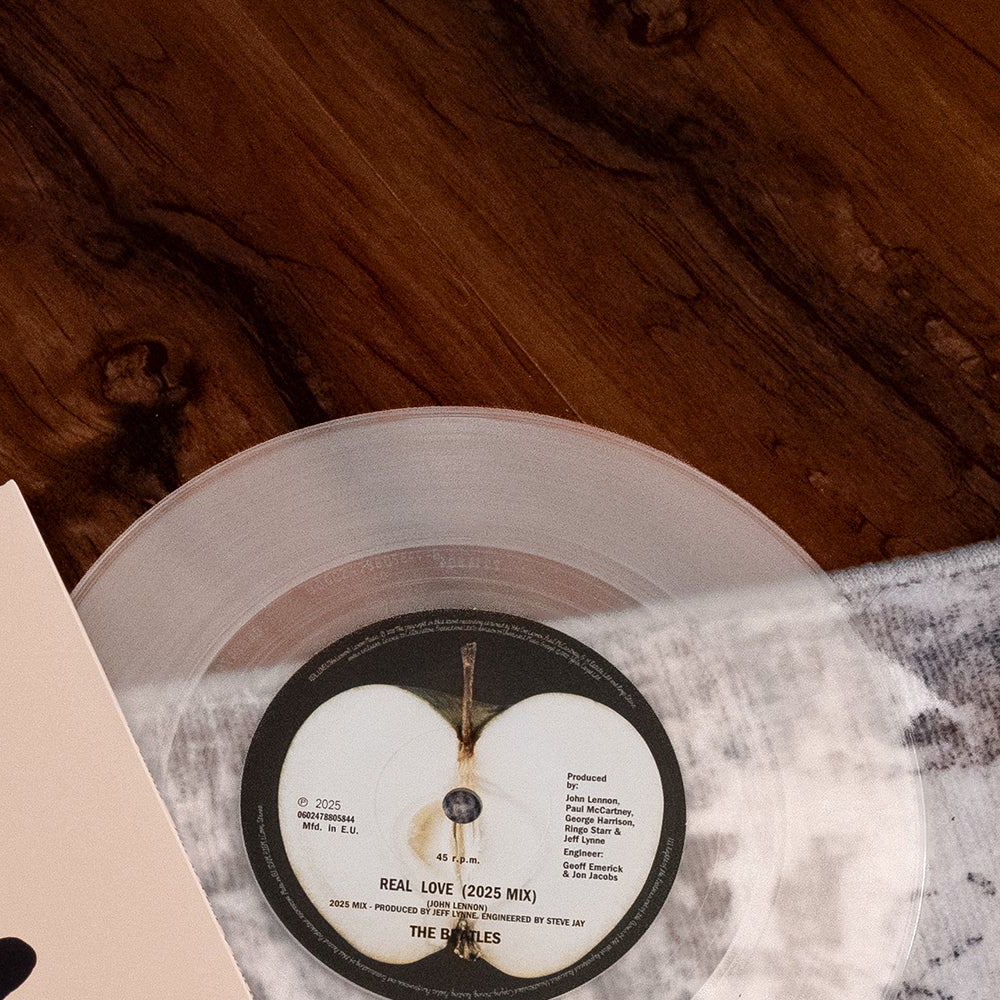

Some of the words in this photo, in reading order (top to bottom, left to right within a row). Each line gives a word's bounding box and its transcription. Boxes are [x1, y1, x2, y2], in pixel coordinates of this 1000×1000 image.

[567, 772, 607, 782] Produced
[566, 781, 579, 790] by:
[315, 798, 342, 811] 2025
[565, 794, 585, 803] John
[587, 796, 620, 805] Lennon,
[565, 804, 584, 813] Paul
[586, 806, 634, 817] McCartney,
[297, 810, 355, 824] 0602478805844
[565, 814, 595, 825] George
[597, 817, 635, 828] Harrison,
[302, 822, 322, 831] Mfd.
[341, 825, 359, 835] E.U.
[564, 825, 589, 835] Ringo
[590, 826, 612, 835] Starr
[614, 828, 621, 836] &
[563, 835, 580, 843] Jeff
[581, 836, 606, 846] Lynne
[436, 853, 448, 862] 45
[452, 856, 480, 865] r.p.m.
[563, 848, 604, 858] Engineer:
[562, 861, 586, 870] Geoff
[589, 862, 624, 873] Emerick
[562, 870, 570, 878] &
[572, 871, 587, 879] Jon
[589, 872, 618, 881] Jacobs
[379, 877, 413, 892] REAL
[421, 880, 454, 896] LOVE
[461, 884, 502, 900] (2025
[506, 887, 537, 905] MIX)
[426, 900, 451, 909] (JOHN
[452, 902, 488, 912] LENNON)
[329, 899, 350, 908] 2025
[351, 901, 368, 910] MIX
[374, 903, 418, 914] PRODUCED
[420, 907, 431, 916] BY
[432, 908, 450, 917] JEFF
[481, 912, 532, 924] ENGINEERED
[533, 916, 545, 925] BY
[546, 917, 570, 927] STEVE
[571, 919, 586, 928] JAY
[409, 924, 437, 939] THE
